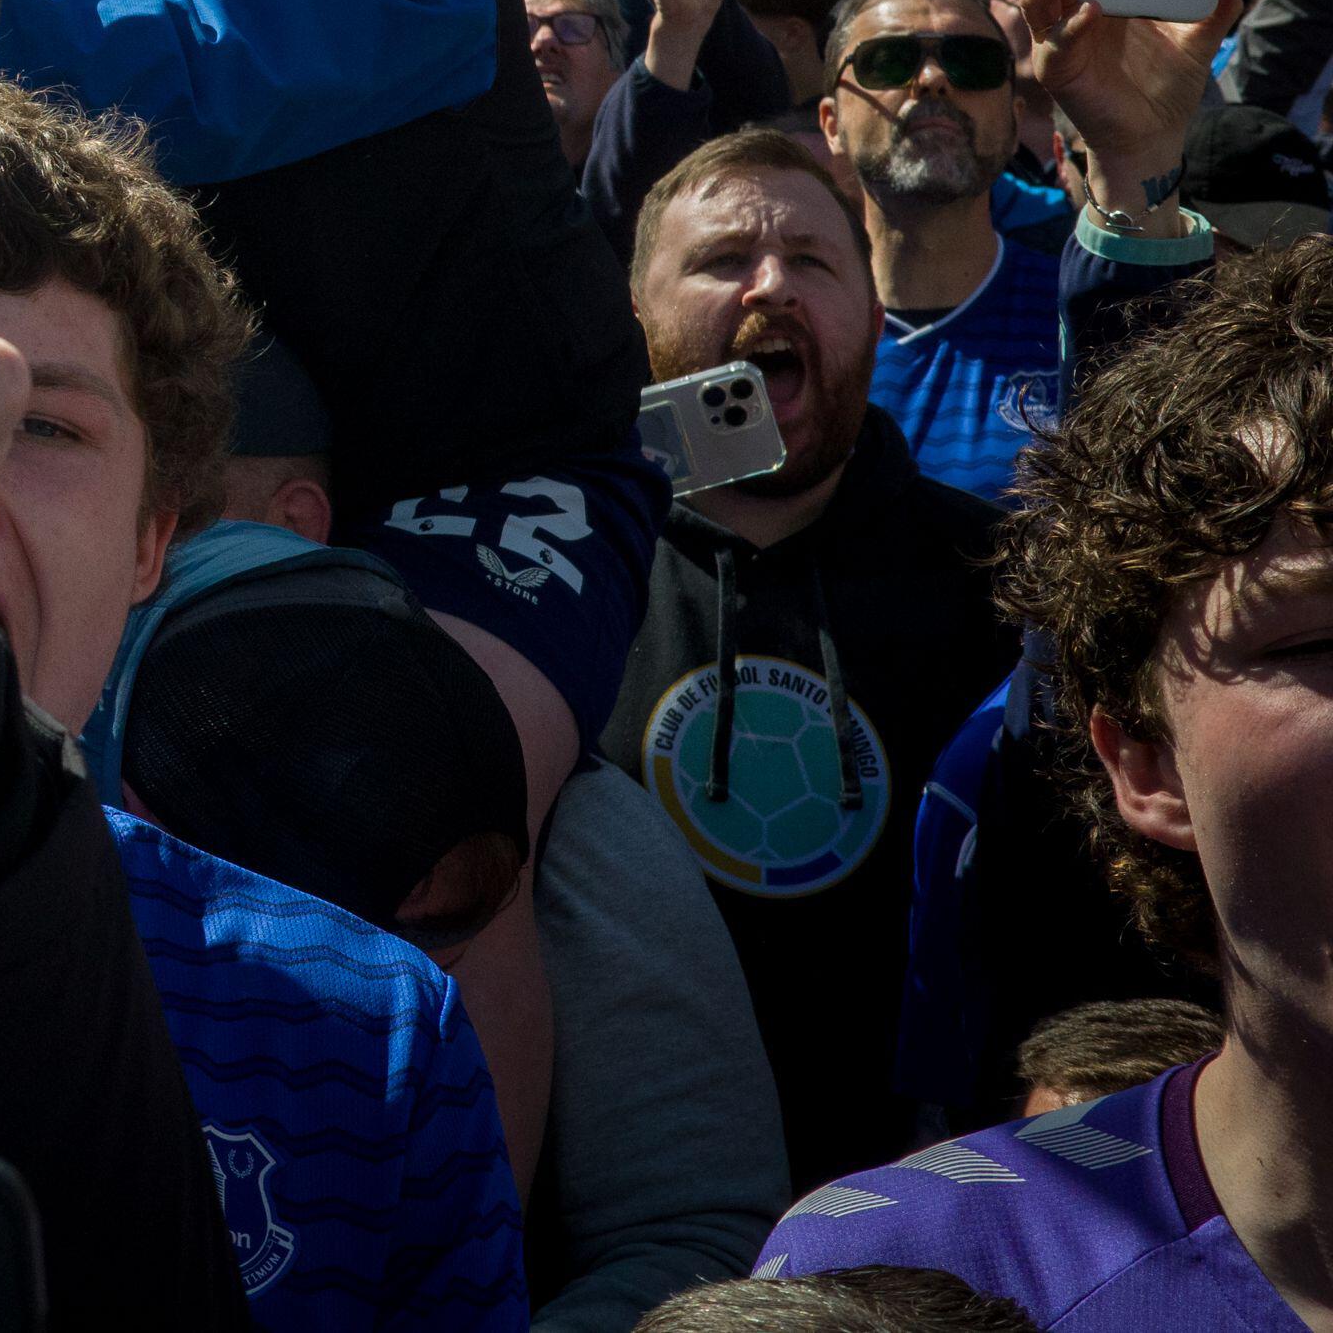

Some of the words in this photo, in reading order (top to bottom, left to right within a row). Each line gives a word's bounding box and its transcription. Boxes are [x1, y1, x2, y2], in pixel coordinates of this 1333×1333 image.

[655, 708, 684, 751] CLUB
[676, 688, 701, 711] DE
[698, 666, 761, 697] FÚBOL
[768, 667, 828, 706] SANTO
[242, 1252, 281, 1287] TIMUM
